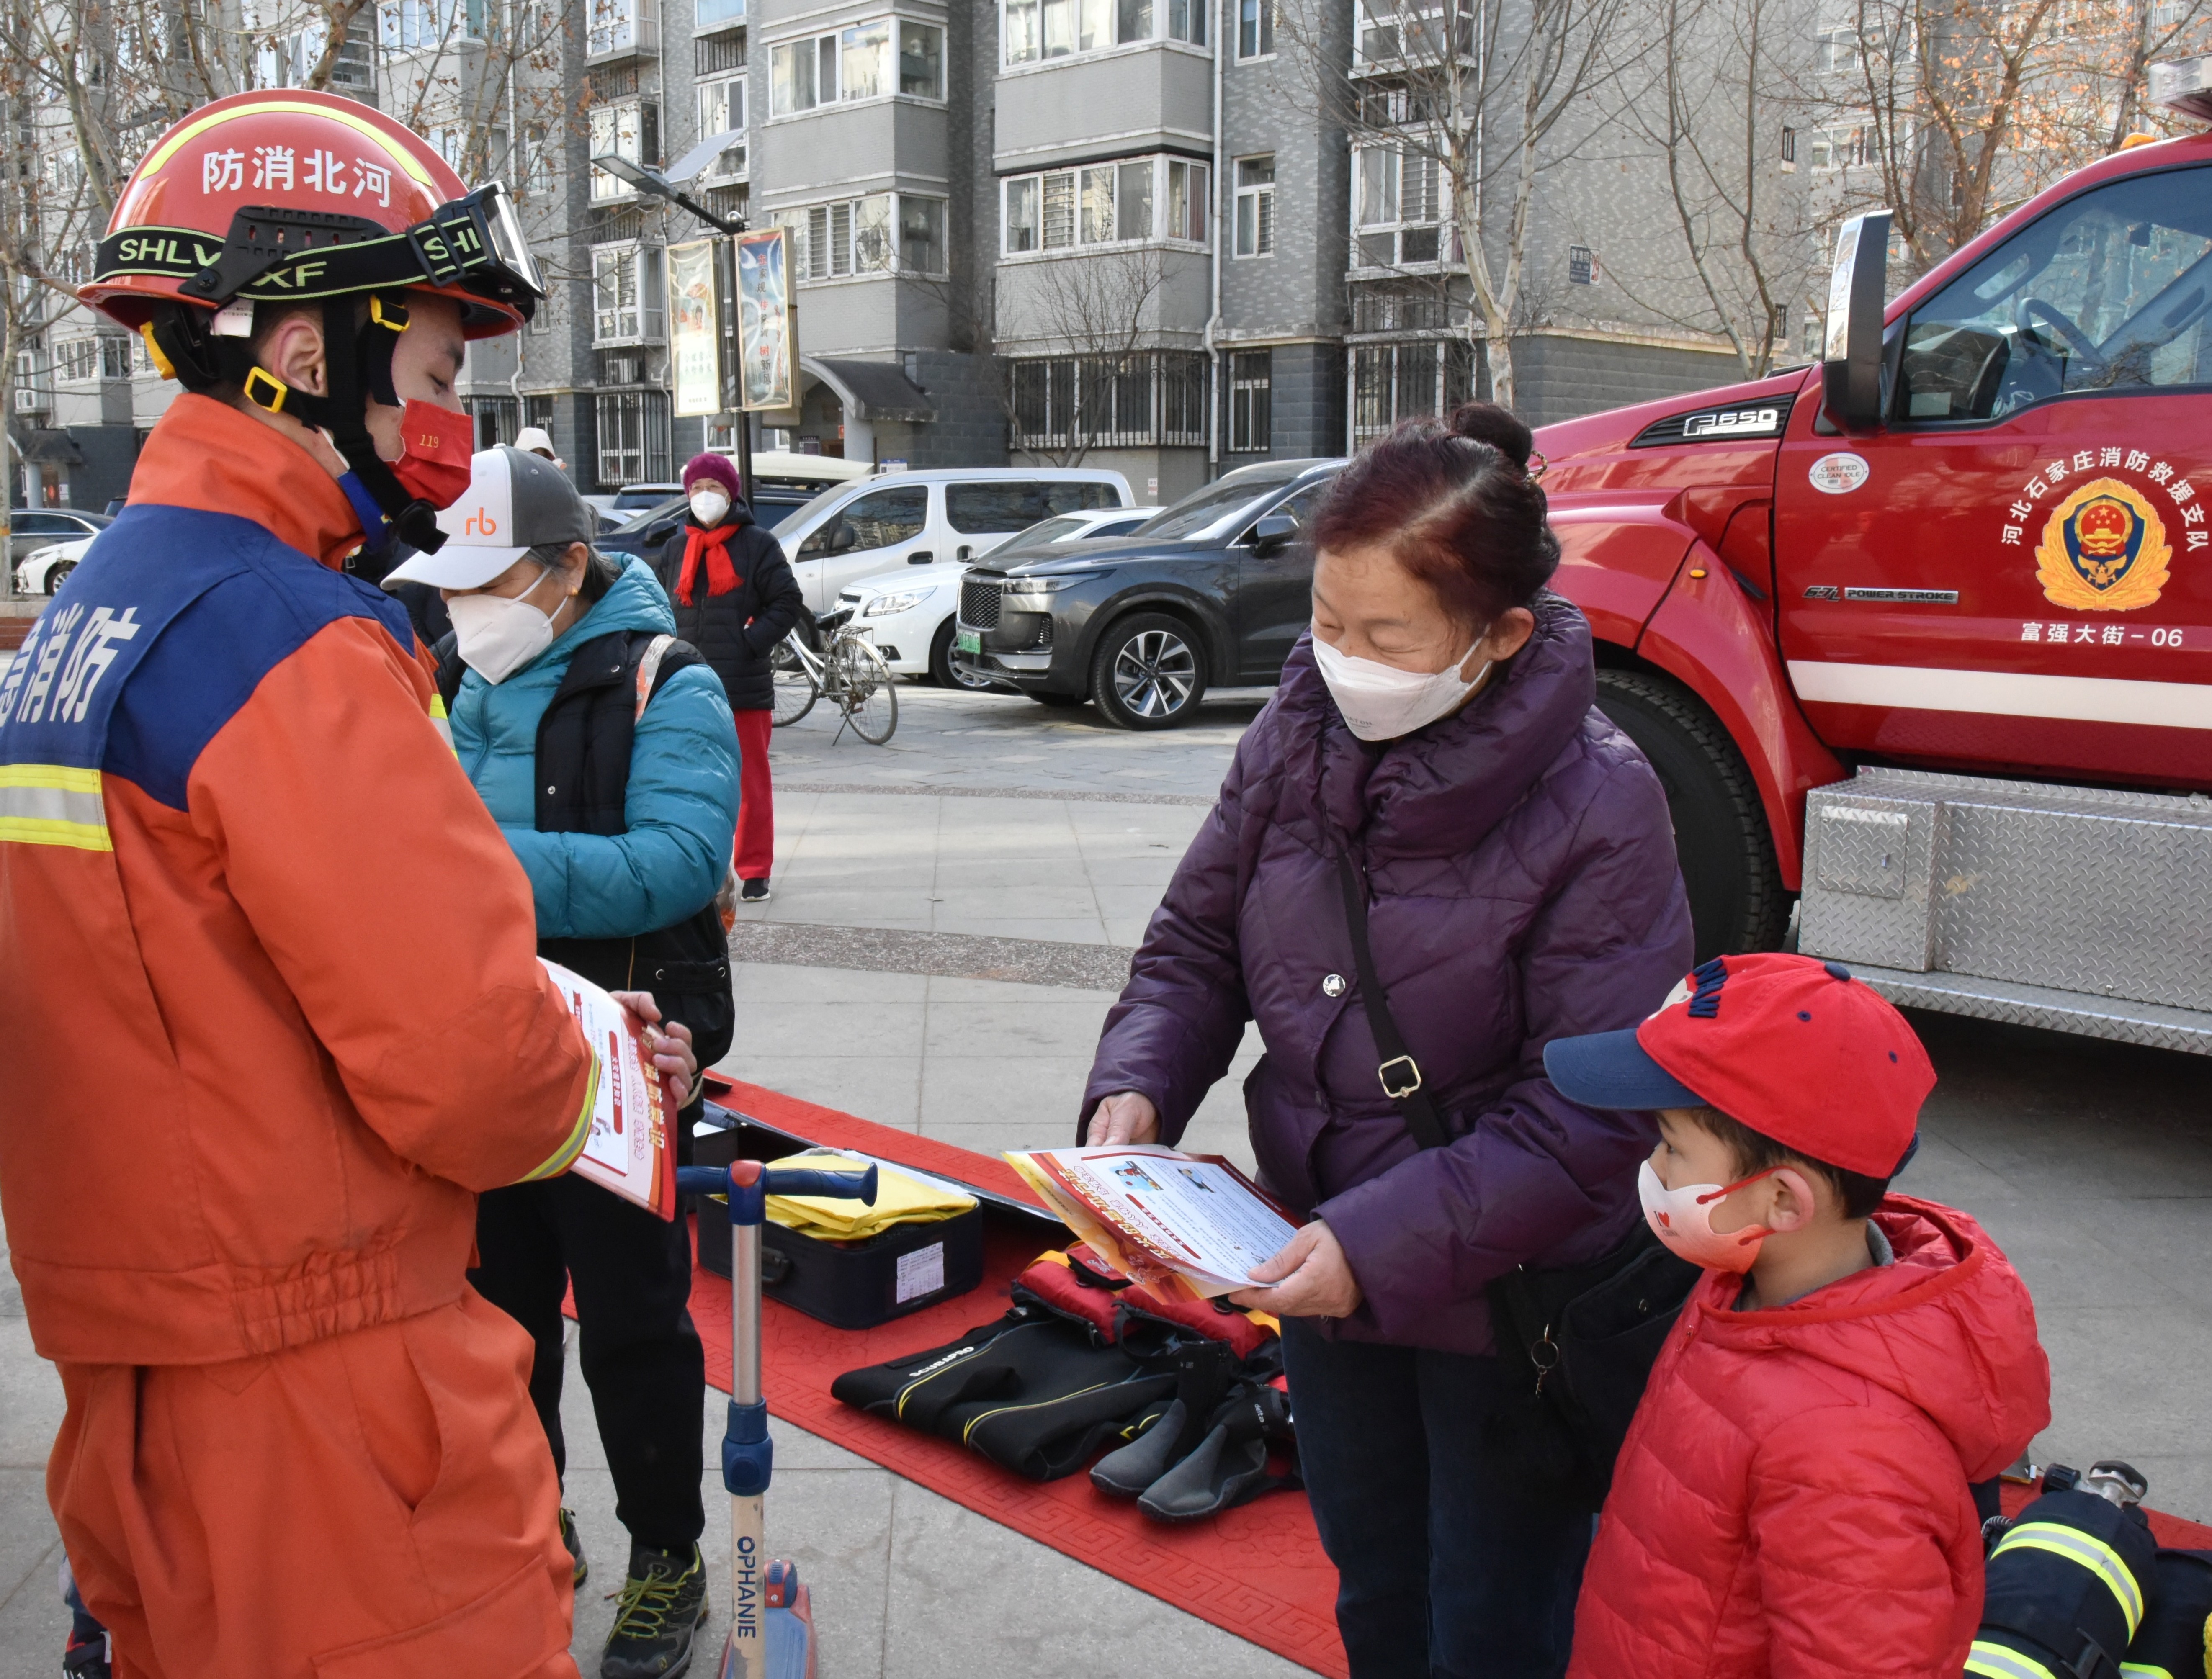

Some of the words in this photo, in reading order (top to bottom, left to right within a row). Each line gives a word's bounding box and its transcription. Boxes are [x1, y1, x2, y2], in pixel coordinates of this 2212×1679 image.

[419, 435, 439, 448] 119
[2001, 447, 2209, 552] 河北石家庄消防救援支队
[466, 507, 497, 536] rb
[1848, 589, 1894, 598] POWER
[1898, 591, 1953, 600] STROKE
[1074, 1165, 1110, 1196] 珍惜生命
[1058, 1169, 1173, 1259] 灭火的基本方法
[1110, 1199, 1149, 1229] 人人有责
[1141, 1207, 1185, 1246] 灭火的基本方法
[909, 1346, 974, 1377] SCUBAPRO
[1254, 1404, 1264, 1423] delta
[737, 1536, 756, 1638] OPHANIE
